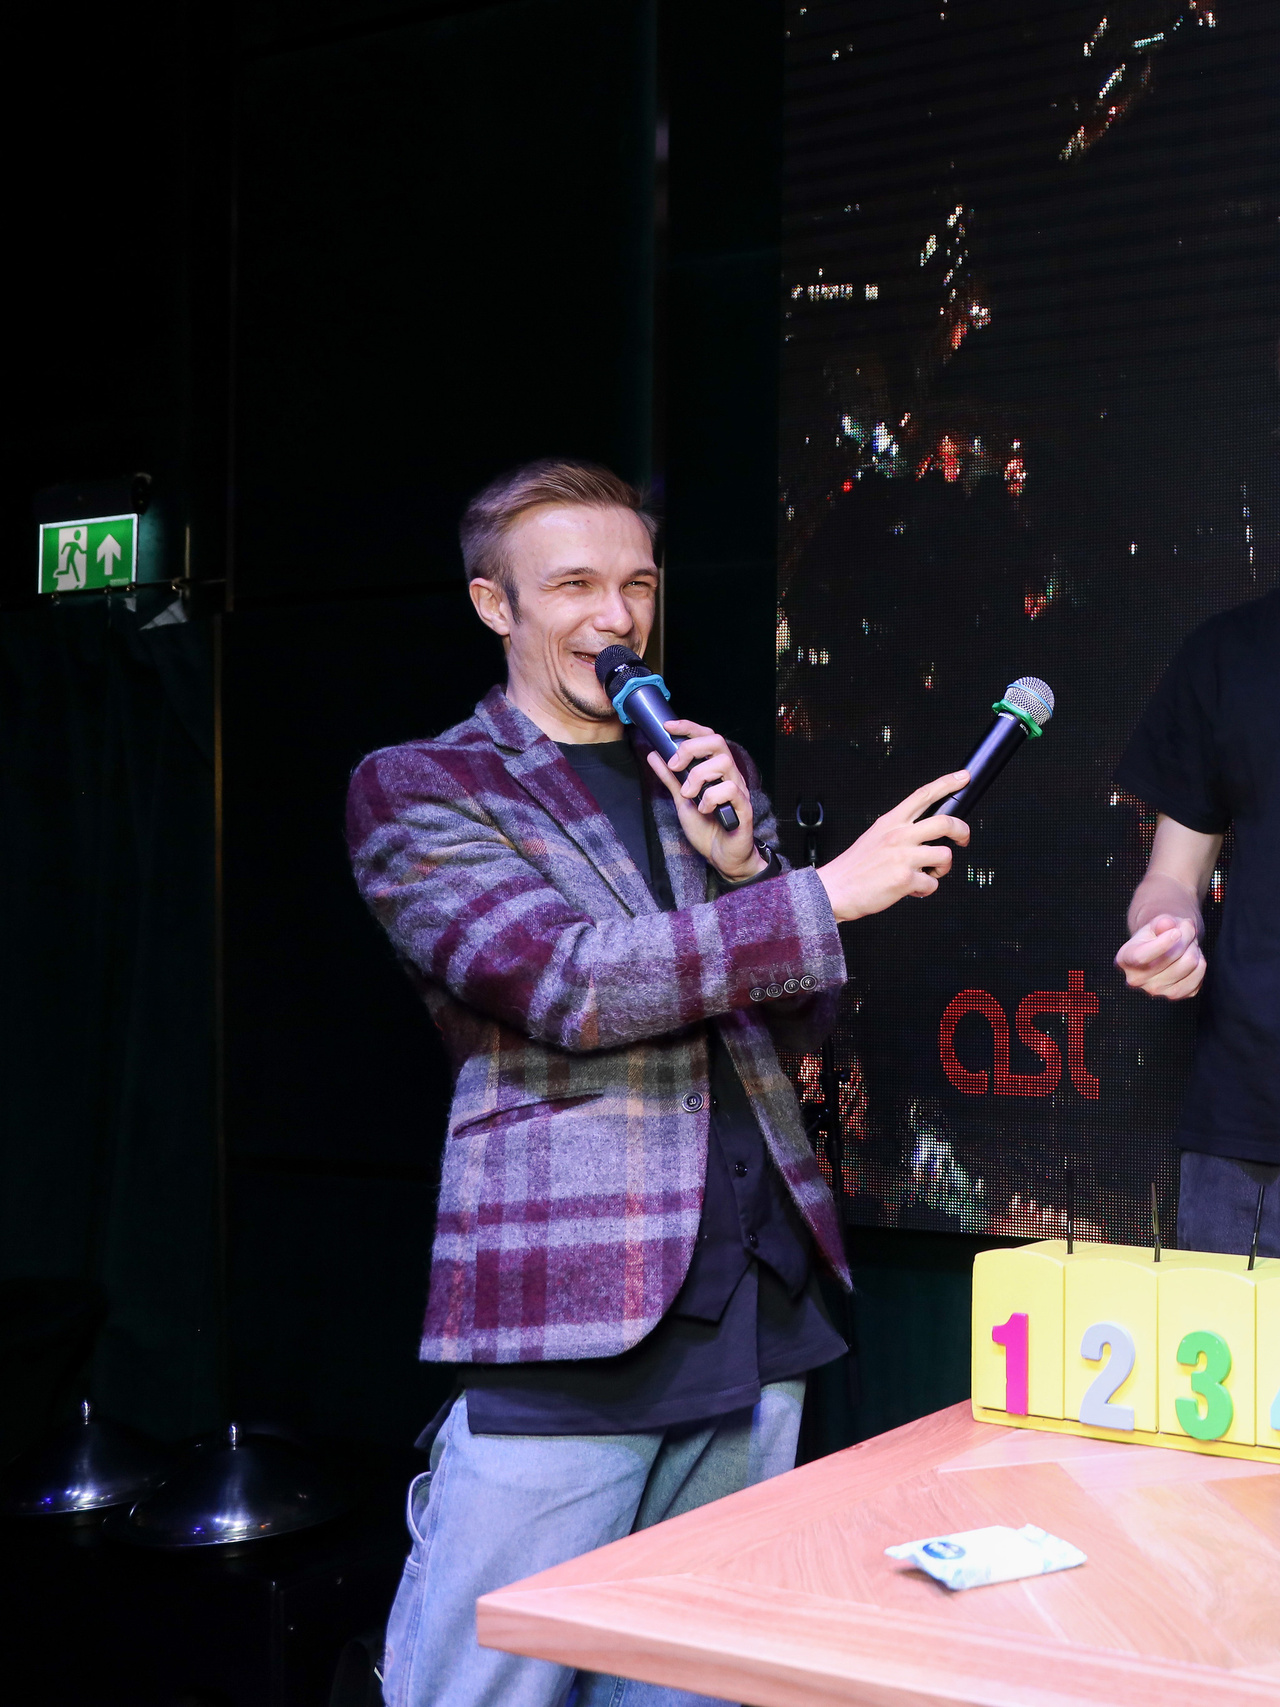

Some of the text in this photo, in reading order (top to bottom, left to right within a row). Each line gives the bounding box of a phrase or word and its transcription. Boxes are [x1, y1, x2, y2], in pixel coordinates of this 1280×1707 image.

[939, 970, 1100, 1100] ast
[992, 1312, 1029, 1415] 1
[1079, 1321, 1136, 1431] 2
[1175, 1330, 1233, 1441] 3
